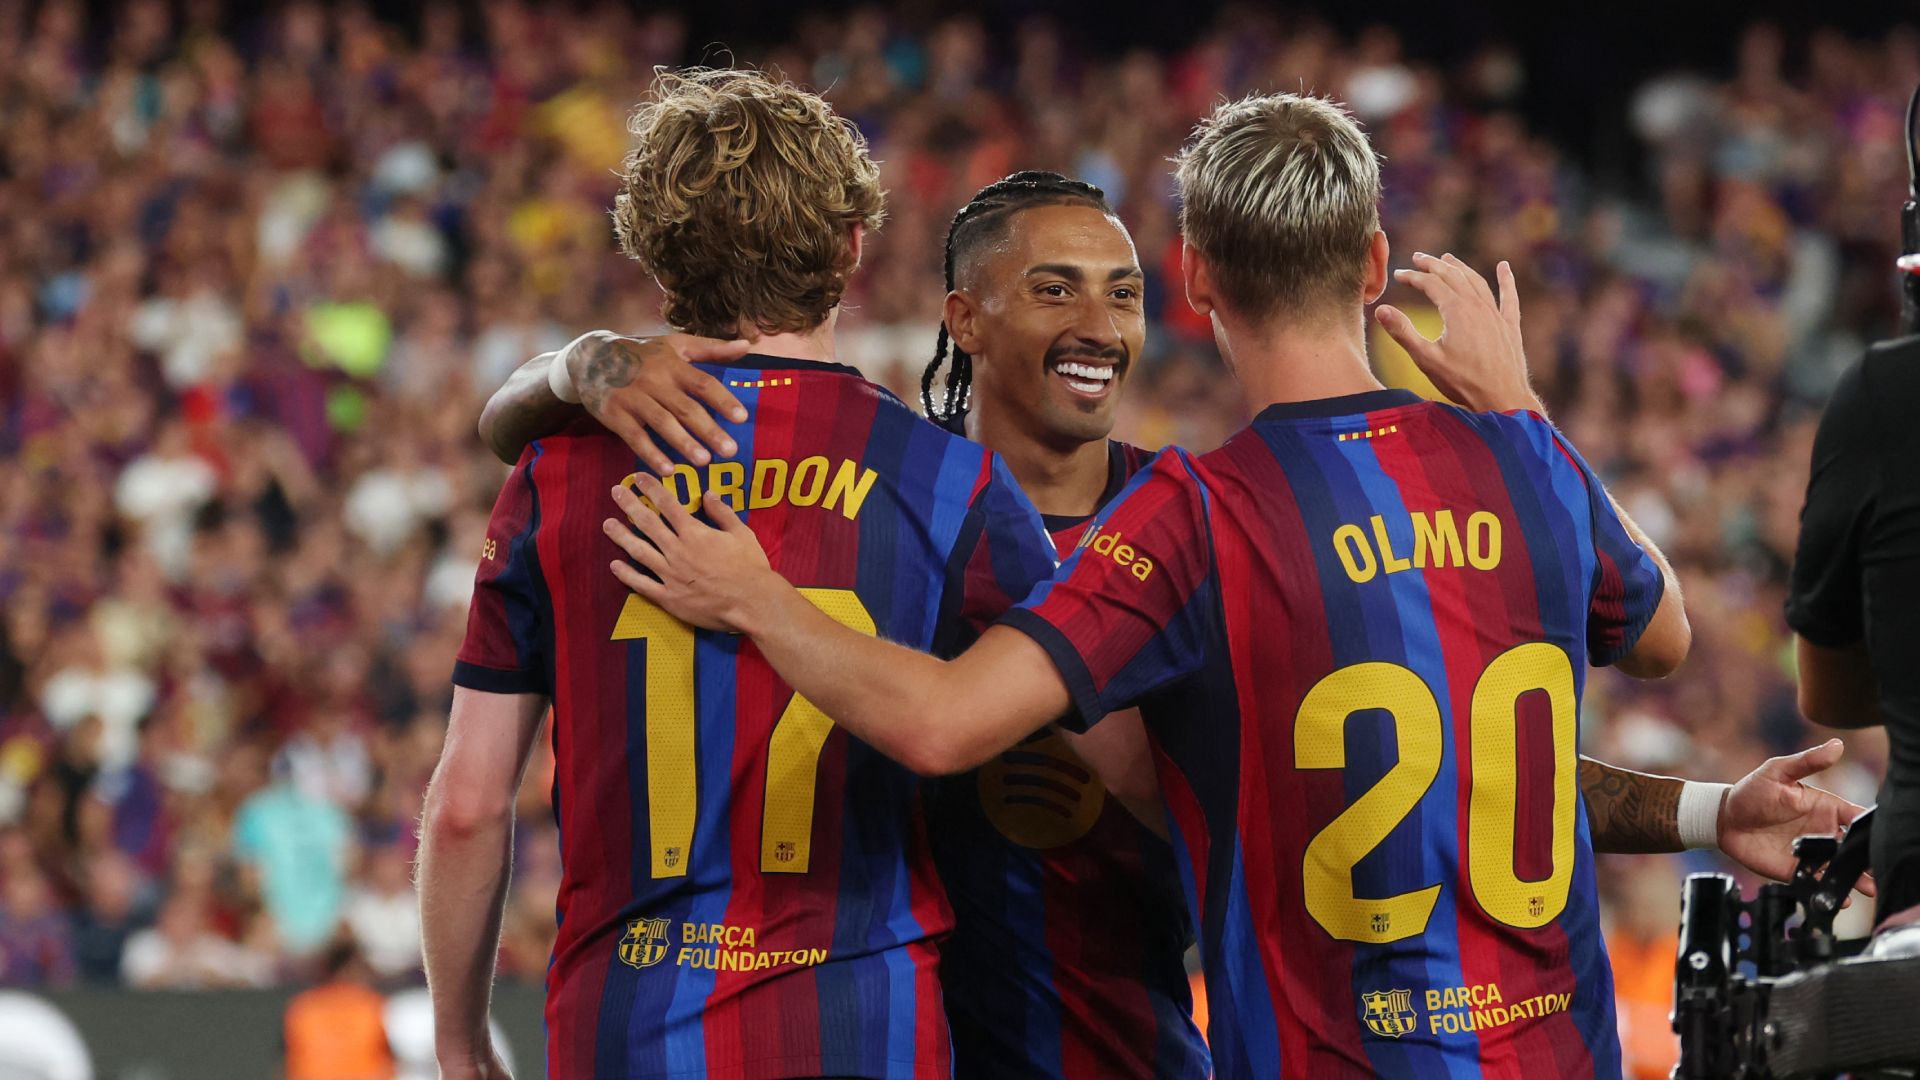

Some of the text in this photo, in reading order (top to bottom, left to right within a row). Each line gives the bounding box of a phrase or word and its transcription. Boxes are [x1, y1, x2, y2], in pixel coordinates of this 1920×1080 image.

[1333, 510, 1502, 583] OLMO
[1294, 642, 1576, 944] 20
[682, 922, 755, 950] BARÇA
[676, 947, 827, 972] FOUNDATION
[1425, 983, 1502, 1010] BARÇA
[1429, 992, 1572, 1034] FOUNDATION
